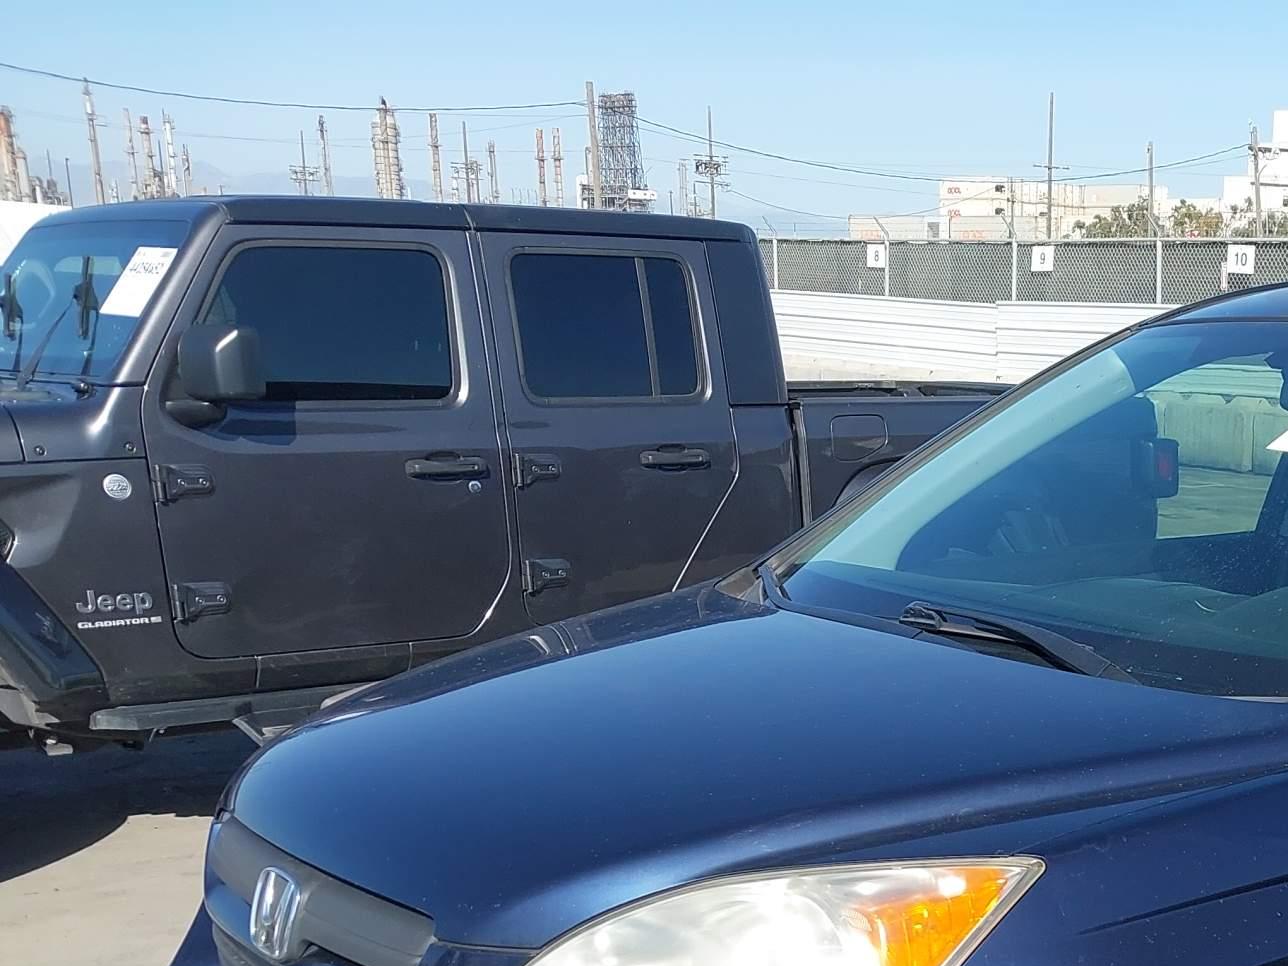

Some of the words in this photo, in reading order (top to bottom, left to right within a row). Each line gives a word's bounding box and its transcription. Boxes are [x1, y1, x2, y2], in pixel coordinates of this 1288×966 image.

[874, 250, 880, 262] 8
[1040, 251, 1046, 265] 9
[1234, 251, 1248, 267] 10
[75, 589, 153, 615] Jeep
[77, 616, 150, 629] GLADIATOR
